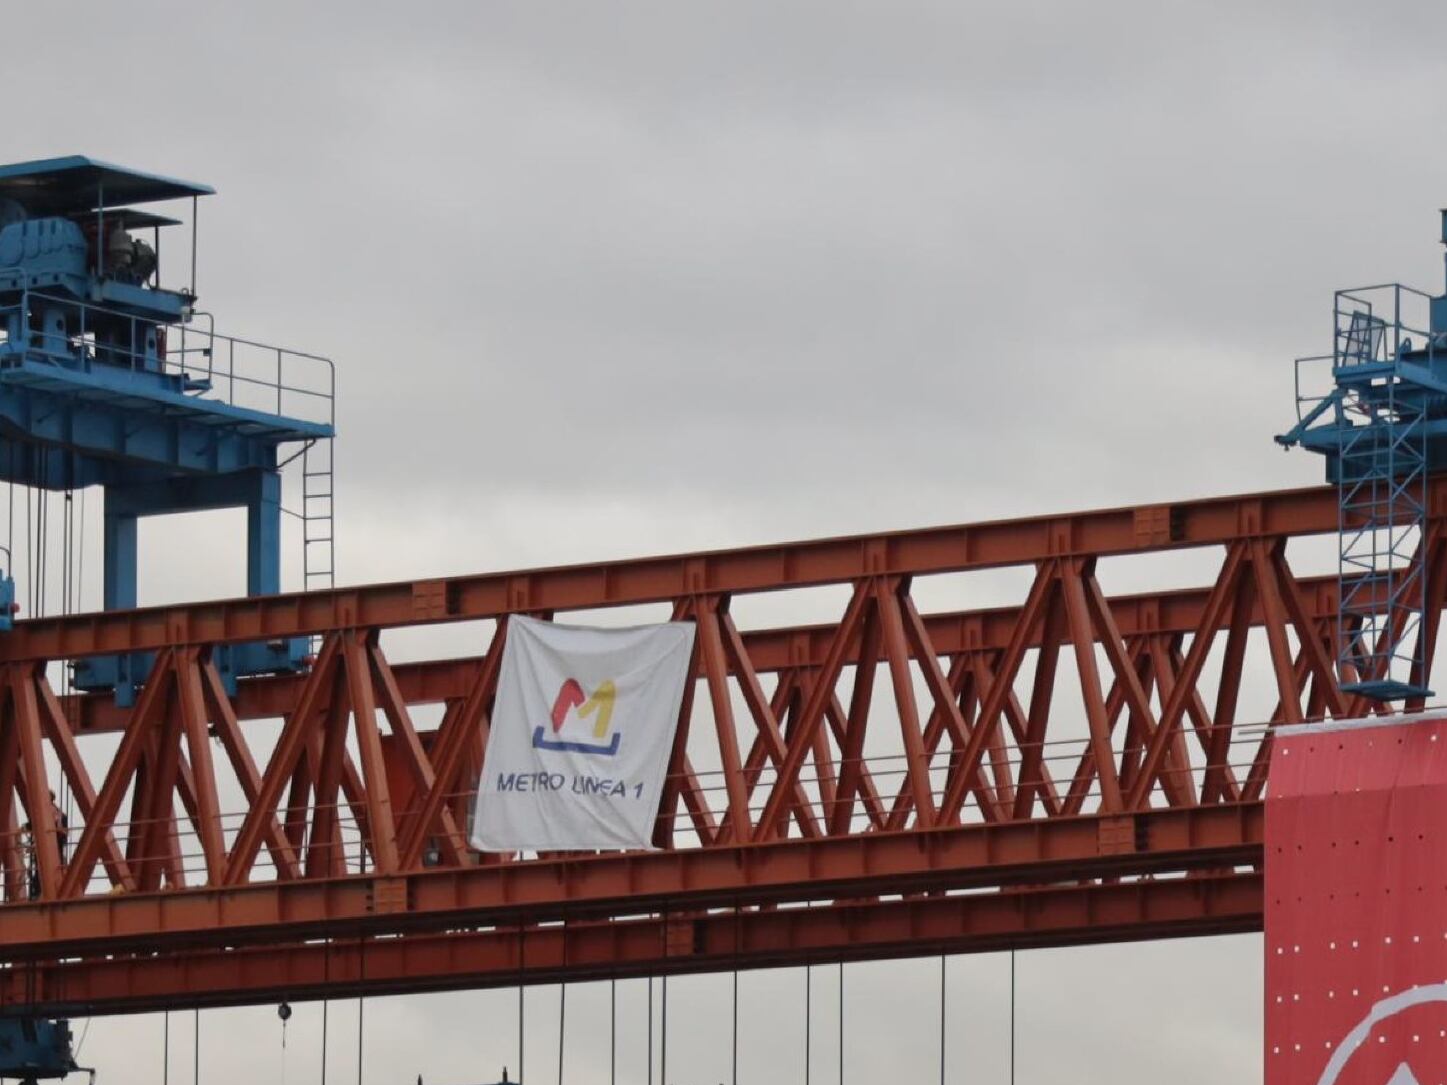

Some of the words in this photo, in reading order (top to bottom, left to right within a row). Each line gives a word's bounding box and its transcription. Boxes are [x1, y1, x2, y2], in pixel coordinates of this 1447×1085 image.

[497, 772, 565, 793] METRO
[572, 775, 626, 798] LINEA
[633, 780, 644, 799] 1
